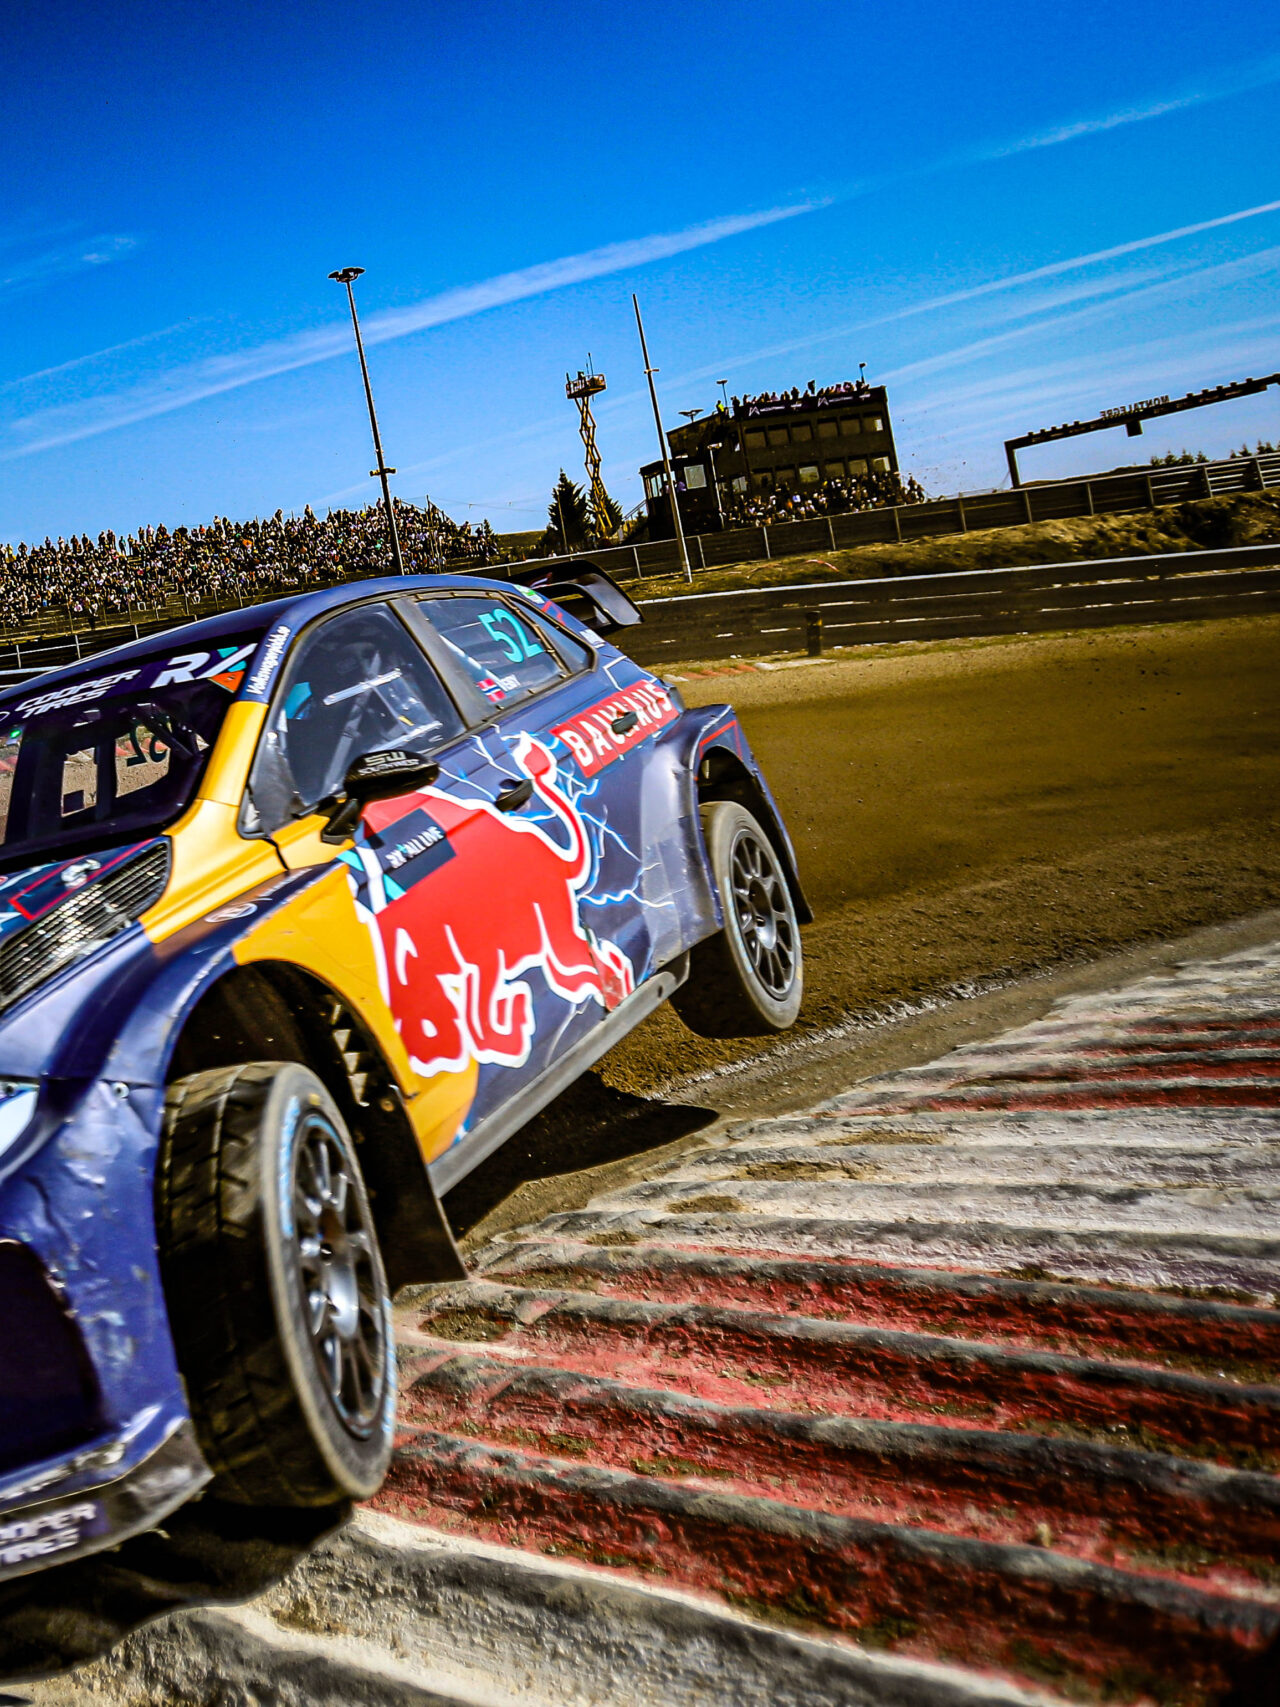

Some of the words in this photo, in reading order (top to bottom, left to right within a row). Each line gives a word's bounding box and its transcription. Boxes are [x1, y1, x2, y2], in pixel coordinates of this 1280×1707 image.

[477, 608, 544, 663] 52
[15, 669, 141, 712] COOPER
[22, 686, 115, 719] TIRES
